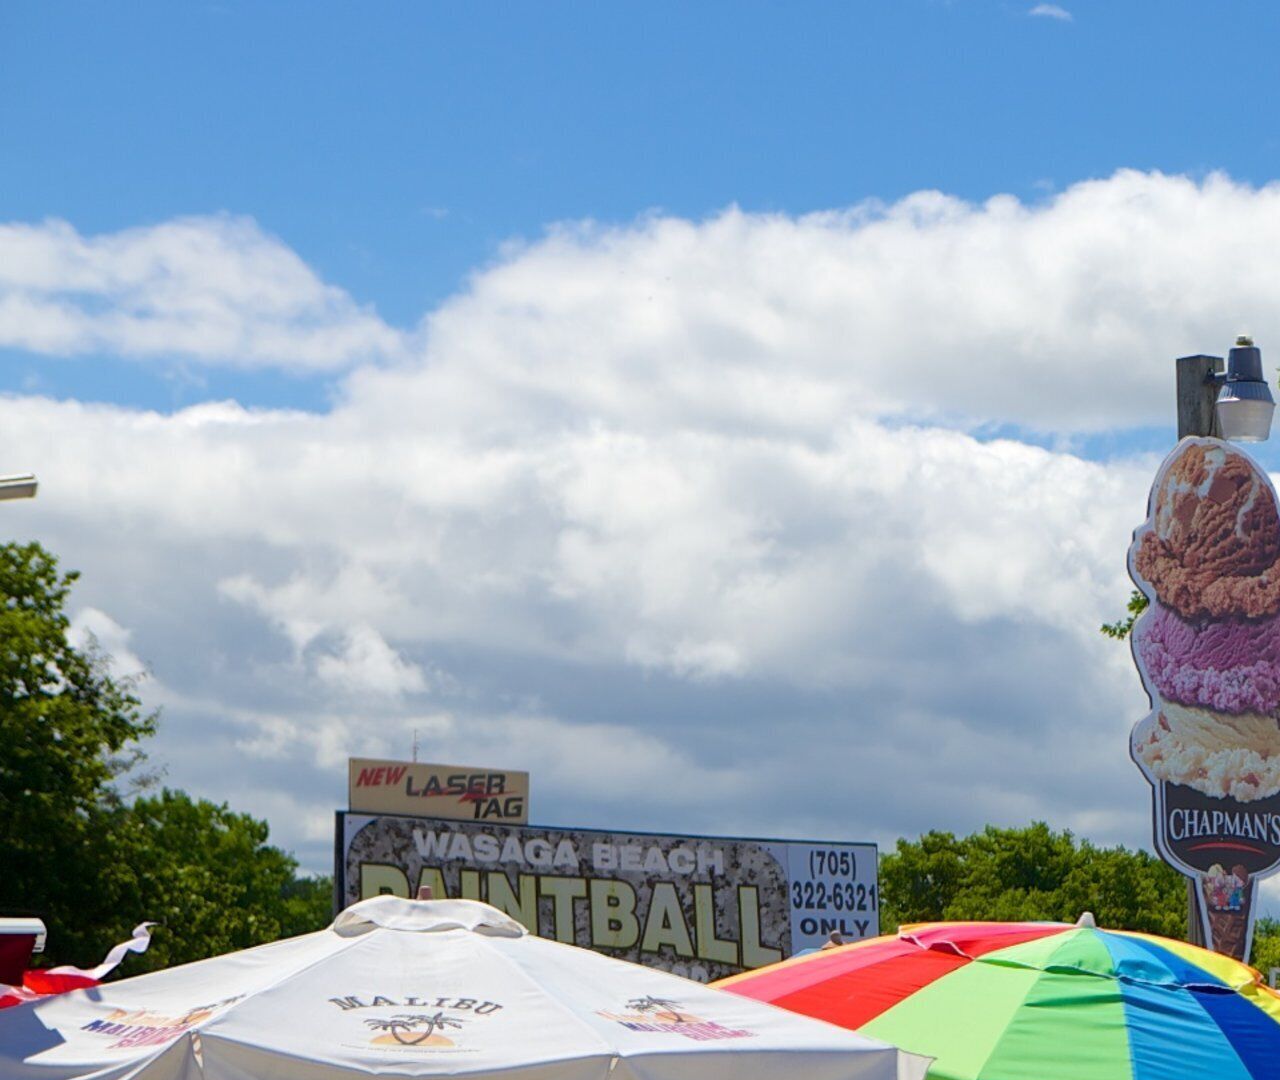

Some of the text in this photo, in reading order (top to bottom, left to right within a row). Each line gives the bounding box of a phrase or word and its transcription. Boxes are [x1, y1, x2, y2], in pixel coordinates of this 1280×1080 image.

[356, 766, 506, 797] NEW LASER
[473, 797, 523, 818] TAG
[413, 828, 724, 875] WASAGA BEACH
[810, 850, 856, 881] (705)
[792, 880, 876, 912] 322-6321
[800, 917, 870, 937] ONLY
[328, 995, 503, 1015] MALIBU
